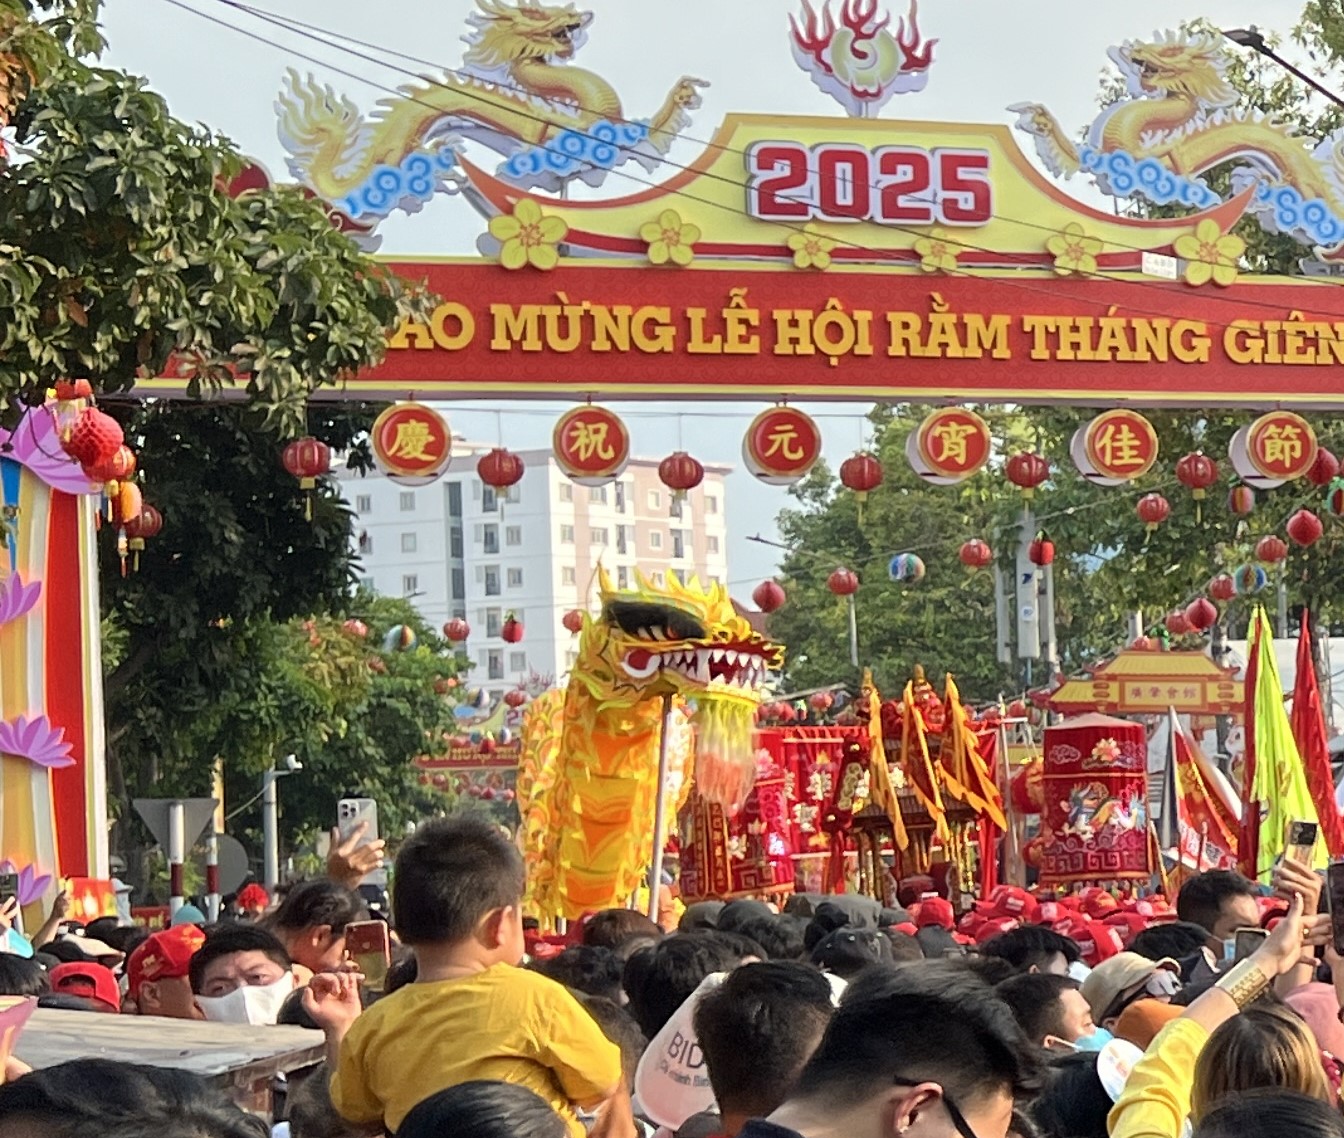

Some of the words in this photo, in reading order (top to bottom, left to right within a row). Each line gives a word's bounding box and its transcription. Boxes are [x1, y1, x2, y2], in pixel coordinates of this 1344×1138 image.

[753, 146, 991, 224] 2025
[490, 291, 677, 353] MỪNG
[686, 287, 760, 355] LỄ
[772, 297, 873, 368] HỘI
[886, 292, 1011, 361] RẰM
[1023, 304, 1211, 366] THÁNG
